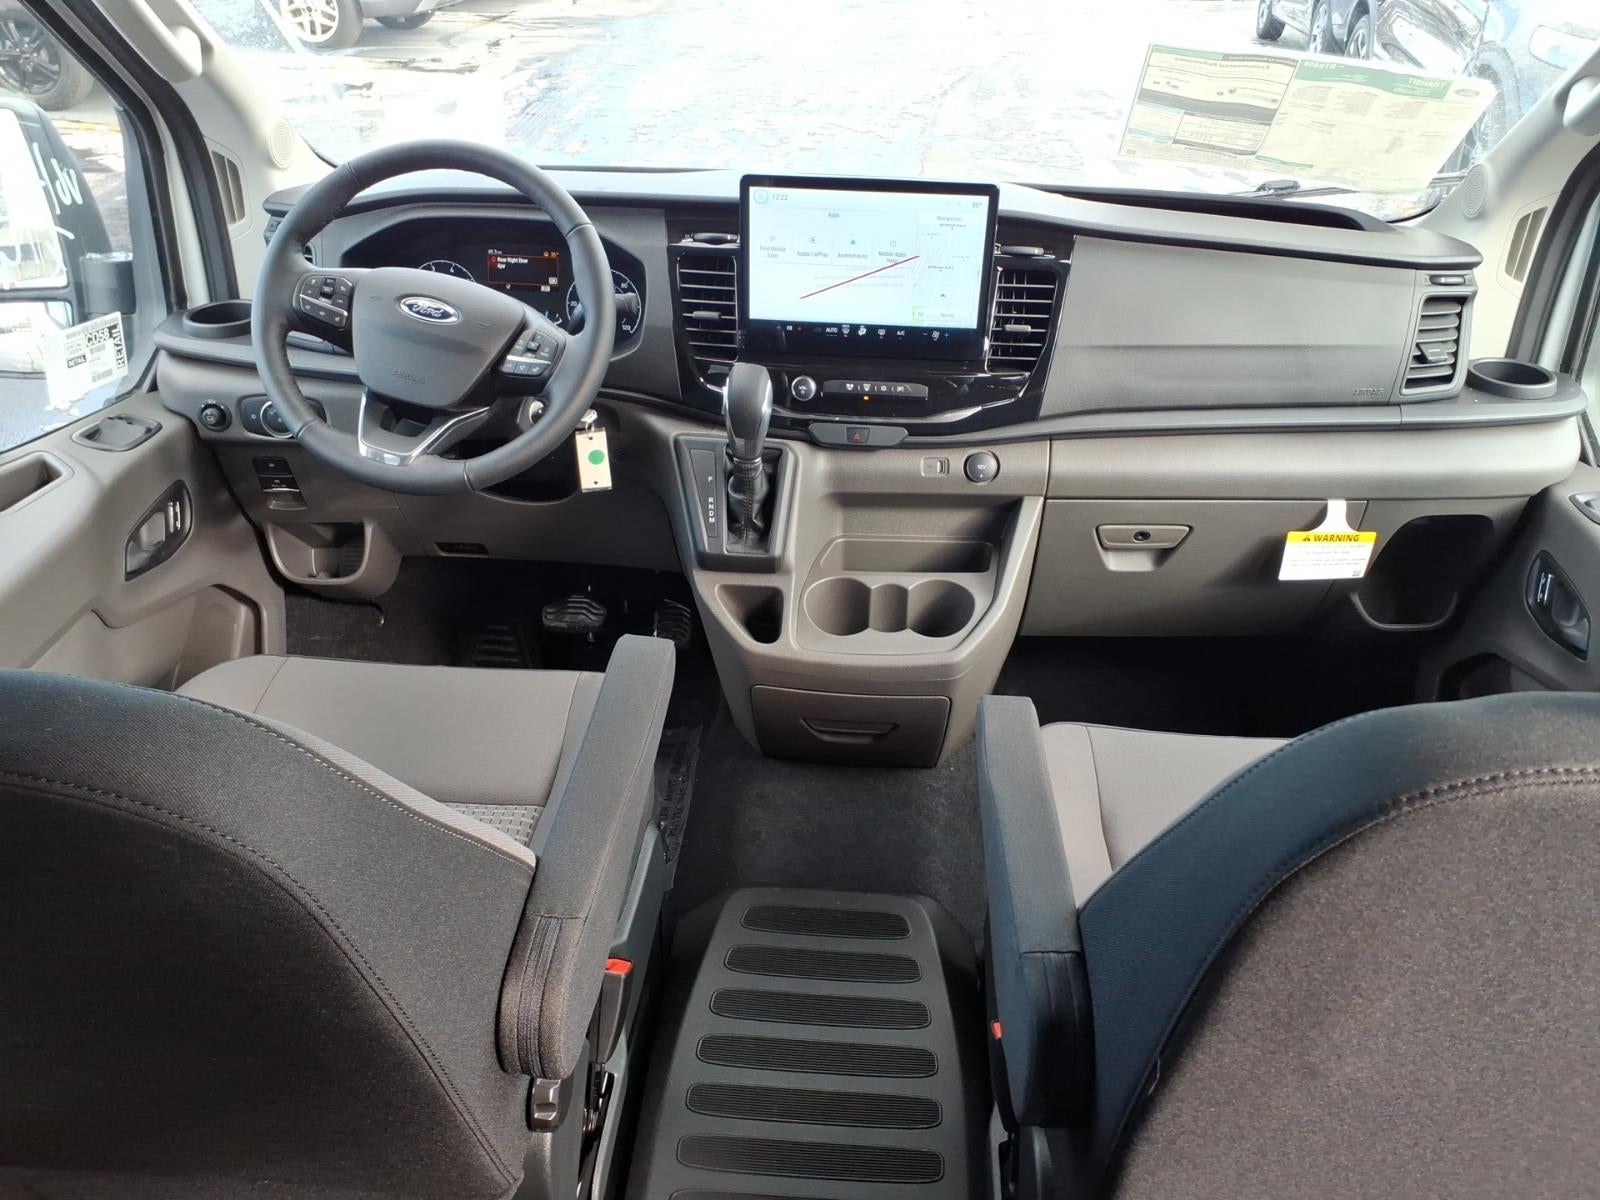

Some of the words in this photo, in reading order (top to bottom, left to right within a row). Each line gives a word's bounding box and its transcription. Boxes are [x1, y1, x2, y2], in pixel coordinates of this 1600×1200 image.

[412, 303, 444, 318] Ford
[86, 327, 110, 347] CD58
[111, 323, 126, 369] RETAIL
[1352, 388, 1384, 396] AIRBAG
[1314, 534, 1359, 542] WARNING
